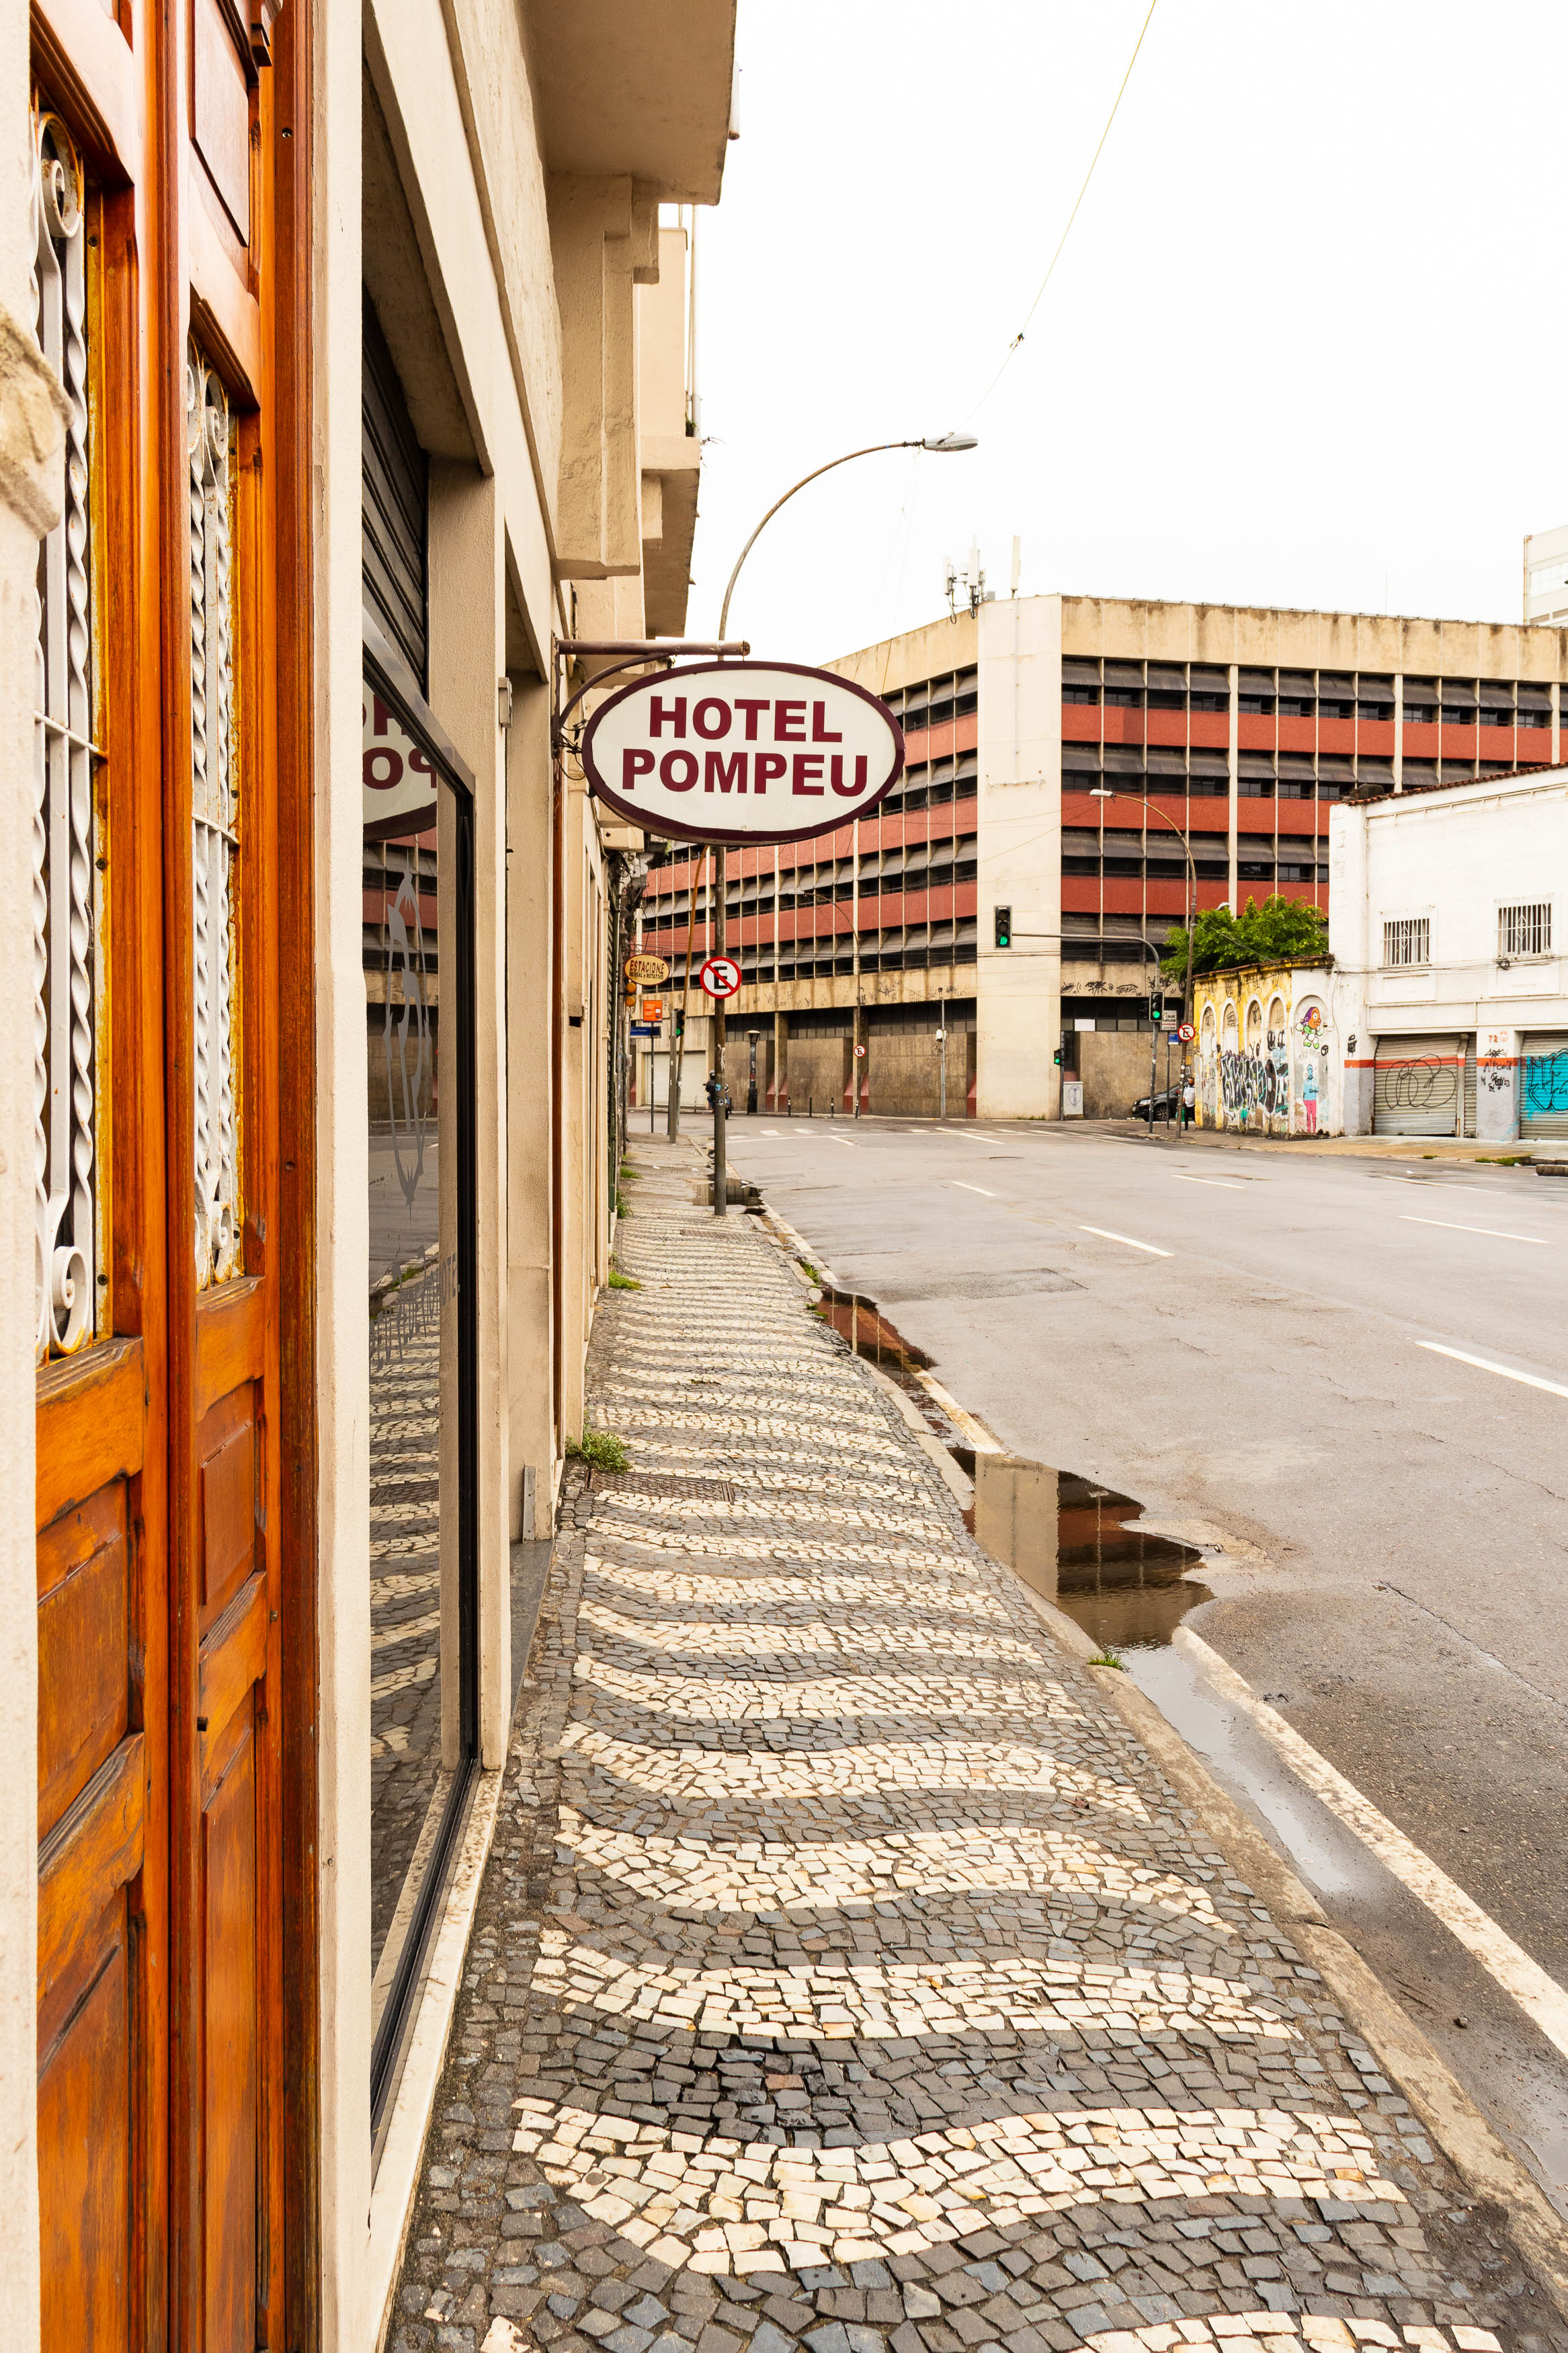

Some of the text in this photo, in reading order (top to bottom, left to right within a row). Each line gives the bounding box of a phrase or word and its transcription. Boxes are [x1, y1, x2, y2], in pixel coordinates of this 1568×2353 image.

[649, 695, 843, 743] HOTEL
[622, 748, 868, 797] POMPEU
[630, 960, 665, 974] ESTACIONE
[714, 966, 728, 989] E
